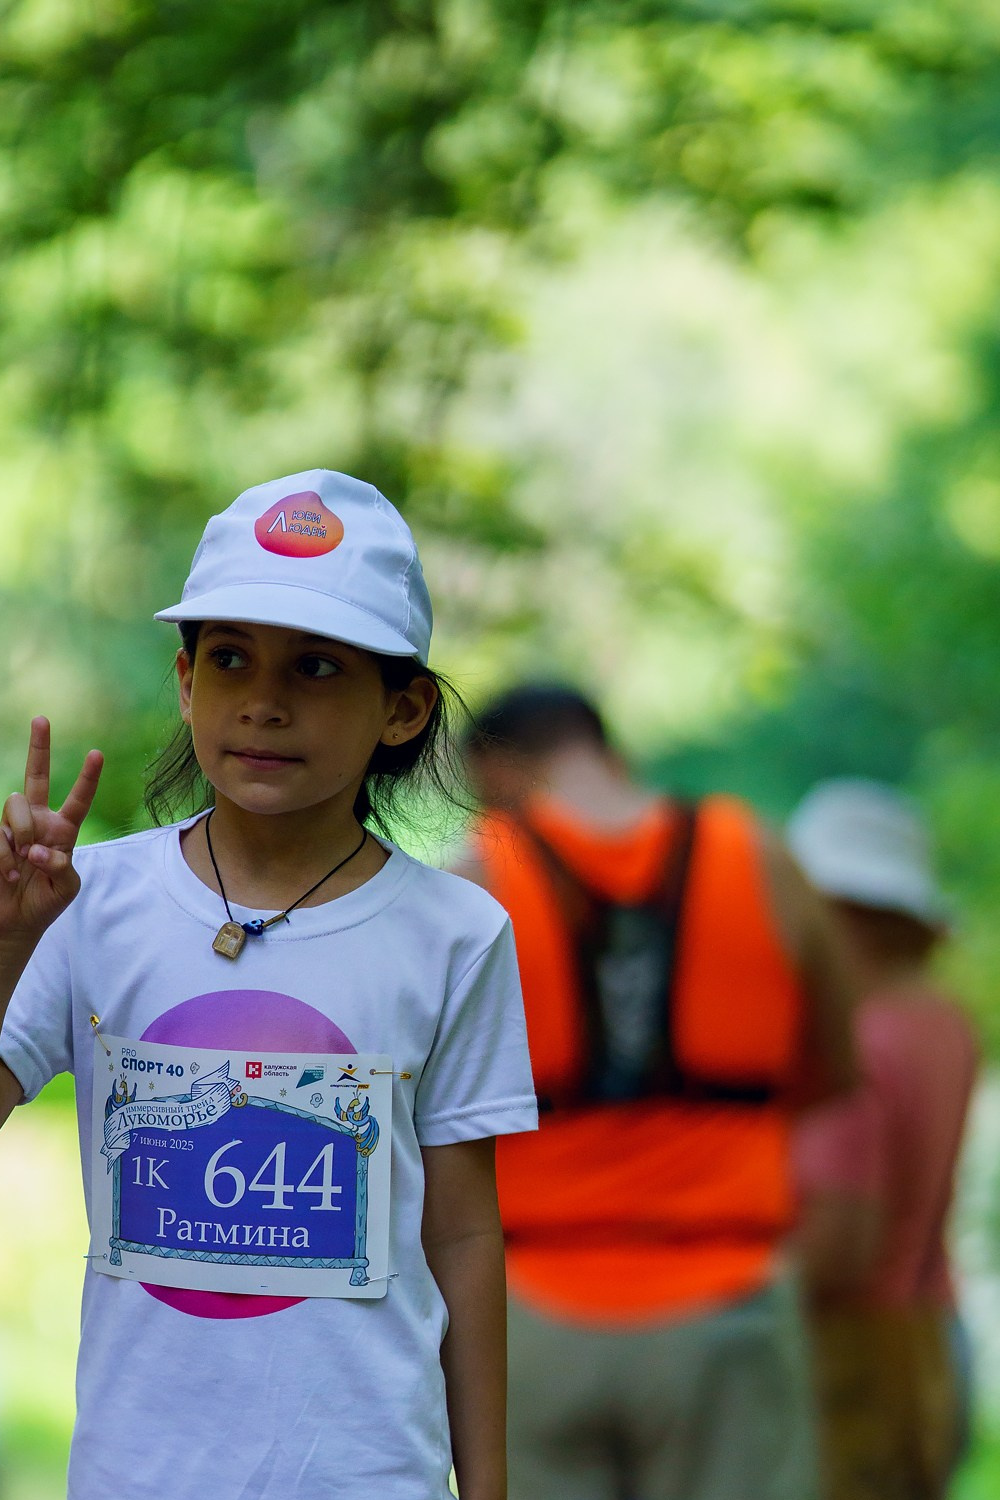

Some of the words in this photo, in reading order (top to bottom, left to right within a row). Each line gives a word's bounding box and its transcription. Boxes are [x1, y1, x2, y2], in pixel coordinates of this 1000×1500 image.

[121, 1047, 137, 1057] PRO
[121, 1057, 164, 1075] СПОРТ
[166, 1064, 184, 1077] 40
[125, 1104, 184, 1114] иммерсивный
[185, 1096, 215, 1114] трейл
[117, 1103, 218, 1131] Лукоморье
[132, 1133, 139, 1143] 7
[140, 1136, 167, 1148] июня
[169, 1138, 194, 1151] 2025
[204, 1139, 342, 1211] 644
[157, 1207, 310, 1248] Ратмина
